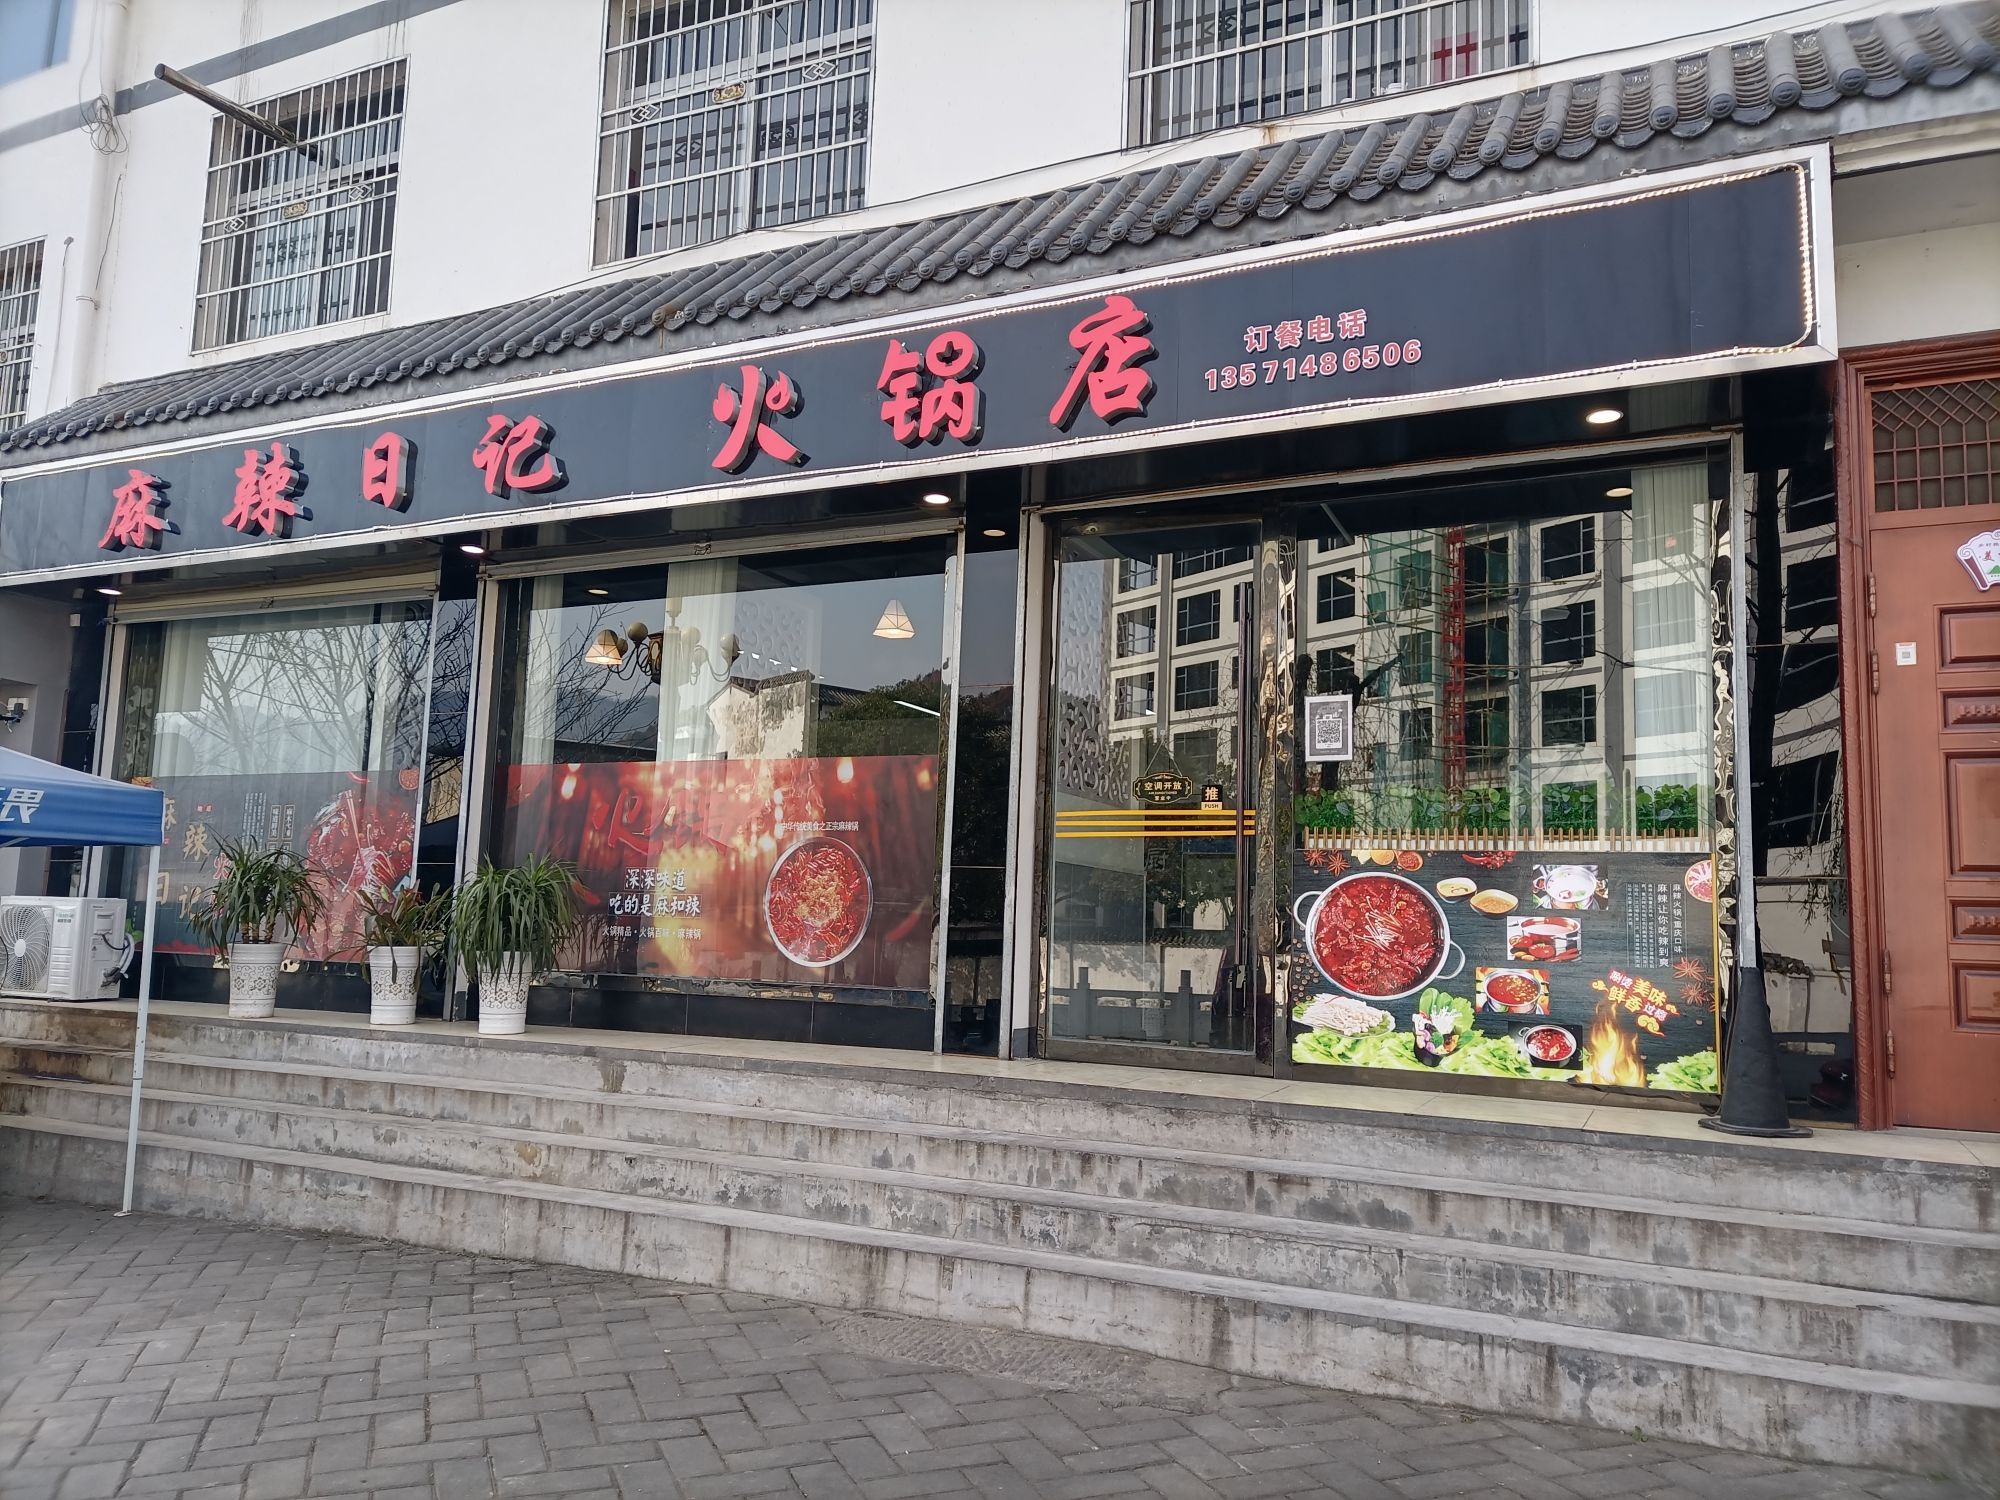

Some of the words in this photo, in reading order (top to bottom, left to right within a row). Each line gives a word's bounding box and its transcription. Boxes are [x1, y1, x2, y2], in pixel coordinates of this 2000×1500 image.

[1244, 308, 1367, 352] 订餐电话
[1144, 781, 1182, 790] 空调开放
[1205, 786, 1219, 801] 推
[0, 787, 45, 824] 畏
[625, 868, 687, 891] 深深味道
[609, 893, 701, 917] 吃的是麻和辣
[1672, 883, 1683, 954] 麻辣火锅/重庆口味
[1657, 883, 1670, 968] 麻辣让你吃辣到爽
